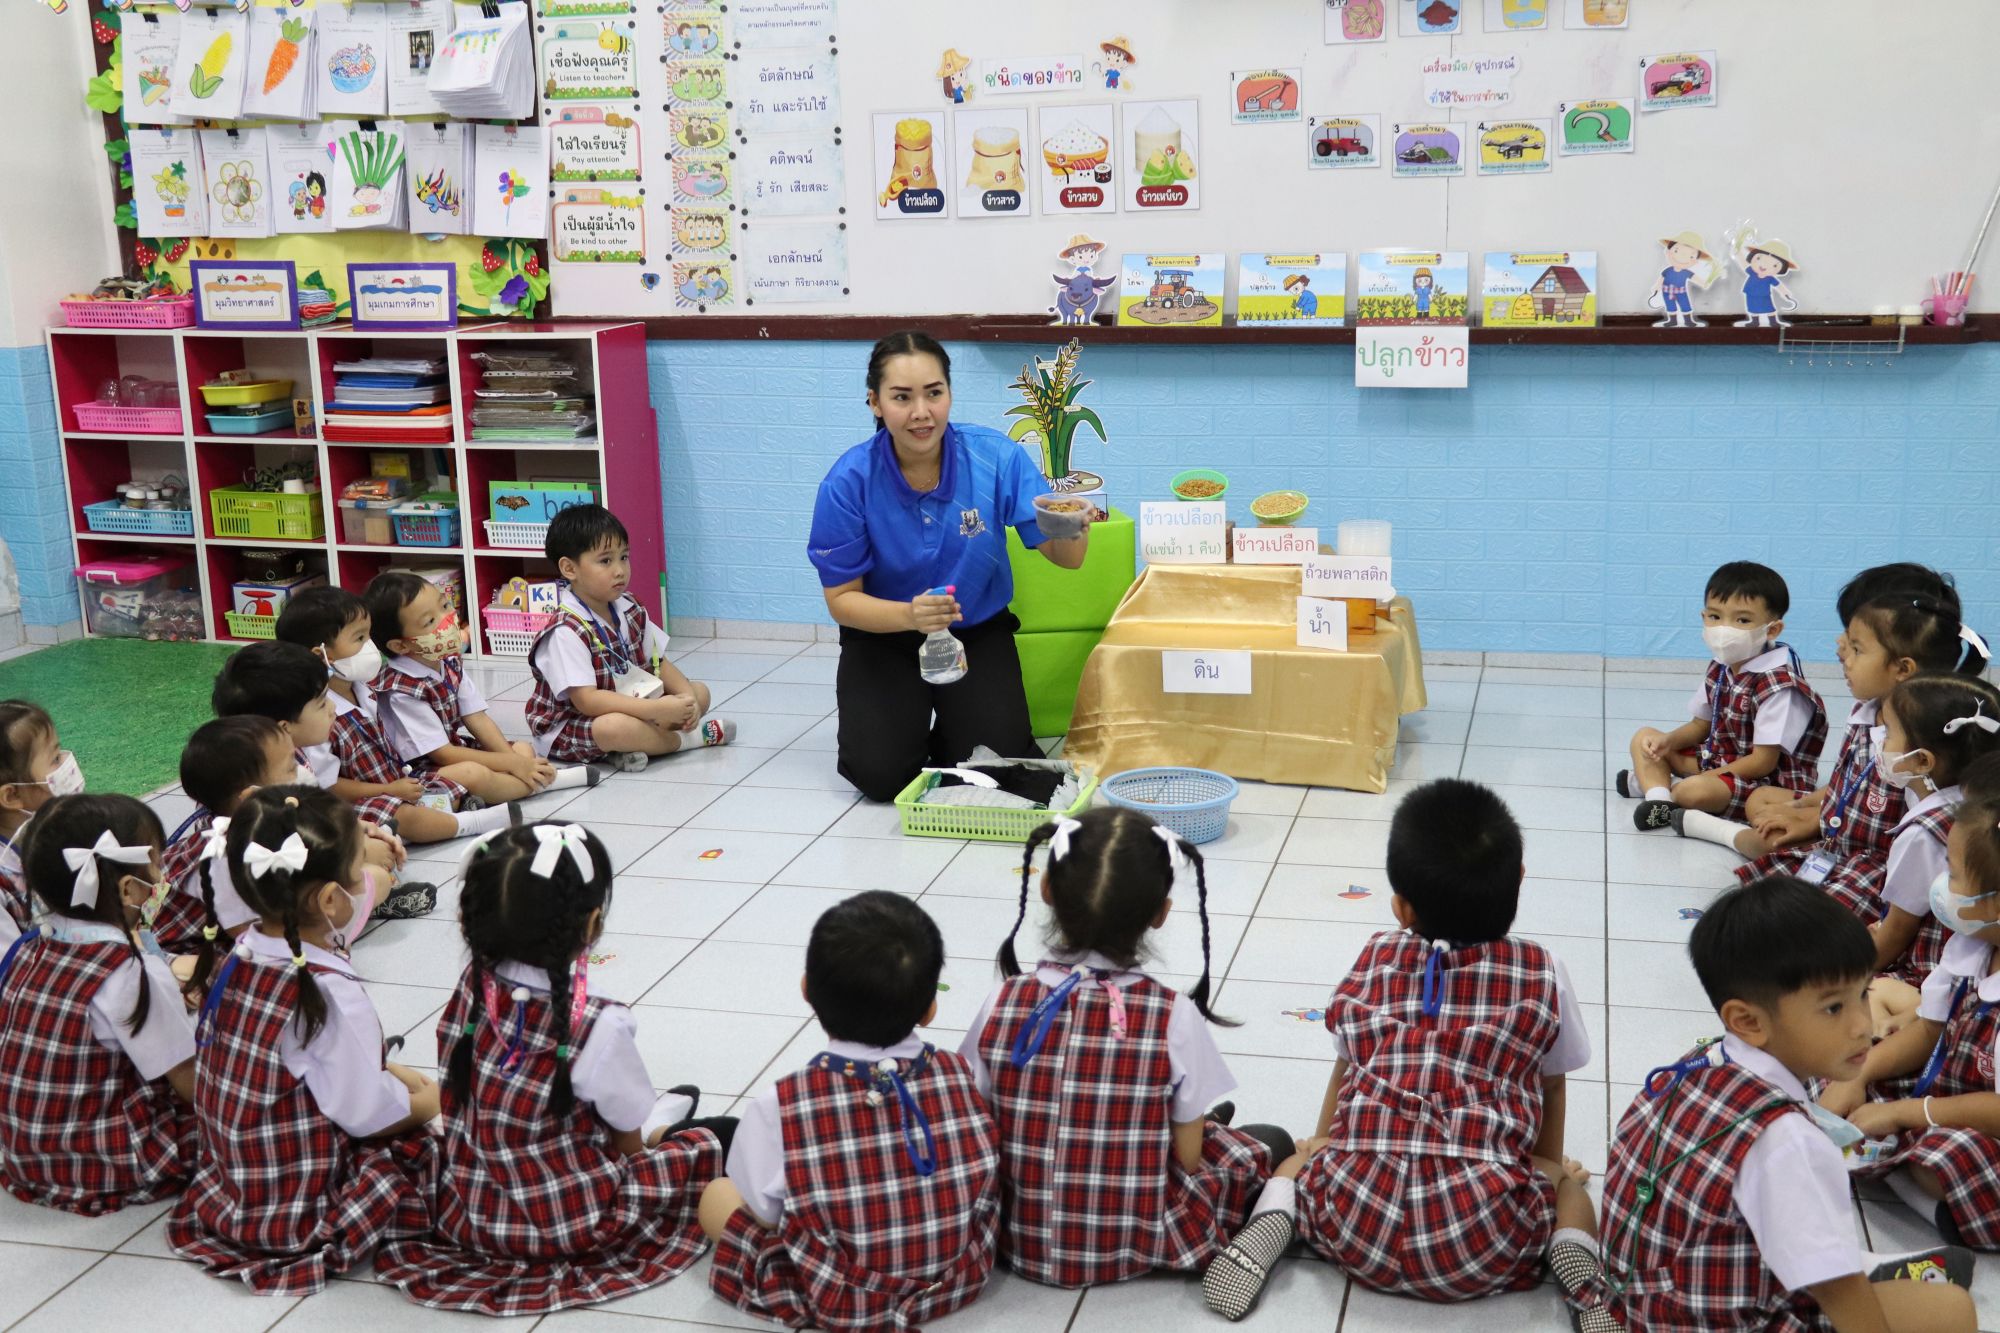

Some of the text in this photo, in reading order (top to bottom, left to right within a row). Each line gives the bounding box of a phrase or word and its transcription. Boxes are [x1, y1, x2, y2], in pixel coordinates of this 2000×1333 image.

[550, 48, 628, 72] เชื่อฟังคุณครู
[1640, 59, 1646, 68] 6
[759, 64, 814, 82] อัตลักษณ์
[985, 62, 1082, 87] ชนิดของข้าว
[1430, 89, 1509, 104] ที่ใช้ในการทำนา
[750, 96, 828, 114] รัก และรับใช้
[1560, 104, 1566, 112] 5
[1310, 118, 1314, 126] 2
[1394, 124, 1400, 133] 3
[1478, 122, 1484, 130] 4
[557, 134, 626, 155] ใส่ใจเรียนรู้
[572, 156, 584, 164] Pay
[770, 149, 812, 165] คติพจน์
[770, 180, 782, 193] รัก
[790, 180, 828, 192] เสียสละ
[986, 194, 1016, 206] ข้าวสาร
[1067, 190, 1098, 202] ข้าวสวย
[1142, 189, 1183, 202] ข้าวเหนียว
[563, 212, 636, 236] เป็นผู้มีน้ำใจ
[768, 249, 822, 264] เอกลักษณ์
[754, 278, 840, 288] เน้นภาษา กิริยางดงาม
[215, 296, 275, 309] มุมวิทยาศาสตร์
[368, 297, 435, 311] มุมเกมการศึกษา
[1357, 336, 1465, 378] ปลูกข้าว
[1144, 508, 1222, 526] ข้าวเปลือก
[1146, 538, 1222, 556] (แช่น้ำ 1 คืน)
[1236, 533, 1315, 553] ข้าวเปลือก
[1305, 564, 1388, 582] ถ้วยพลาสติก
[1310, 607, 1331, 635] น้ำ
[1194, 659, 1220, 679] ดิน
[1684, 1057, 1705, 1069] SAINT
